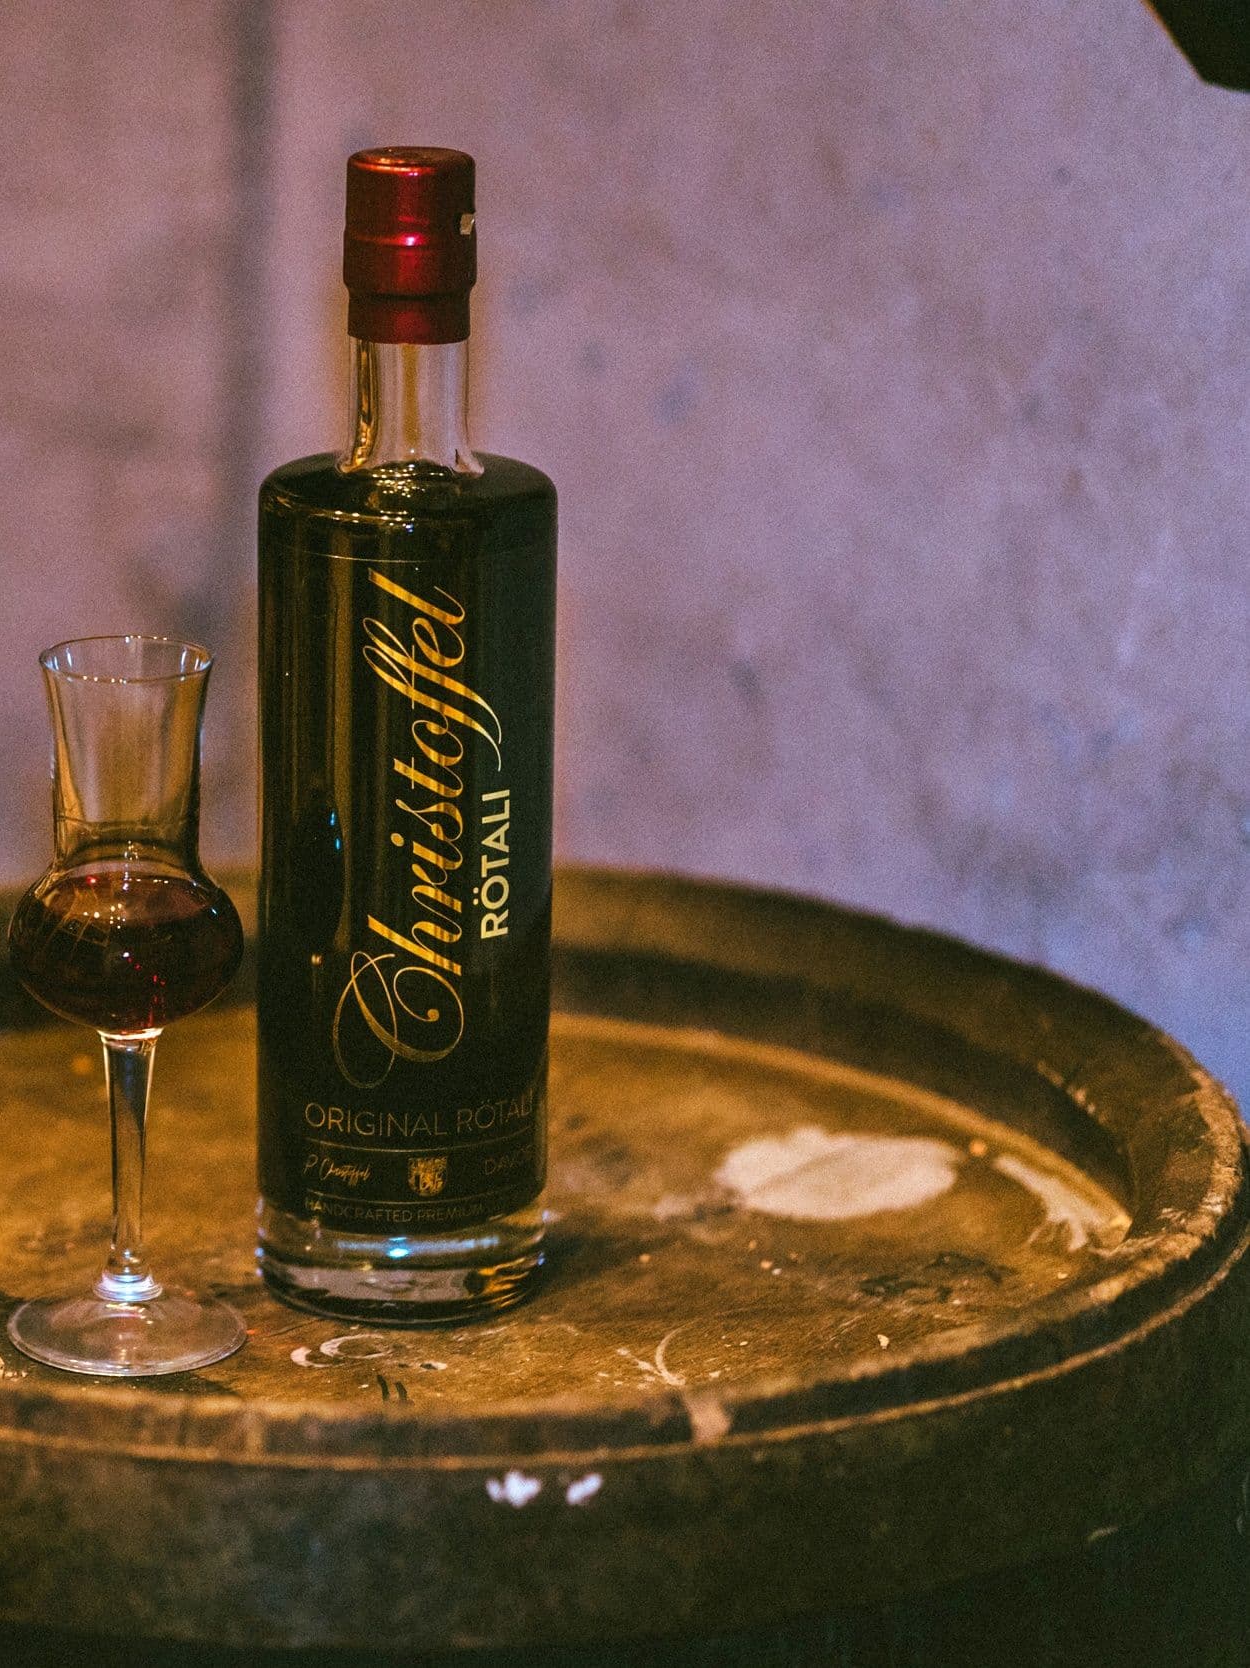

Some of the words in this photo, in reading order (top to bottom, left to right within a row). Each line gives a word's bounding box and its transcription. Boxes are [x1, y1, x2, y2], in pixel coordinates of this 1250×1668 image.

[333, 567, 502, 1089] Christoffel
[472, 788, 510, 940] RÖTALI
[304, 1102, 448, 1137] ORIGINAL
[456, 1087, 534, 1133] RÖTALI
[304, 1196, 414, 1223] HANDCRAFTED
[416, 1202, 484, 1222] PREMIUM
